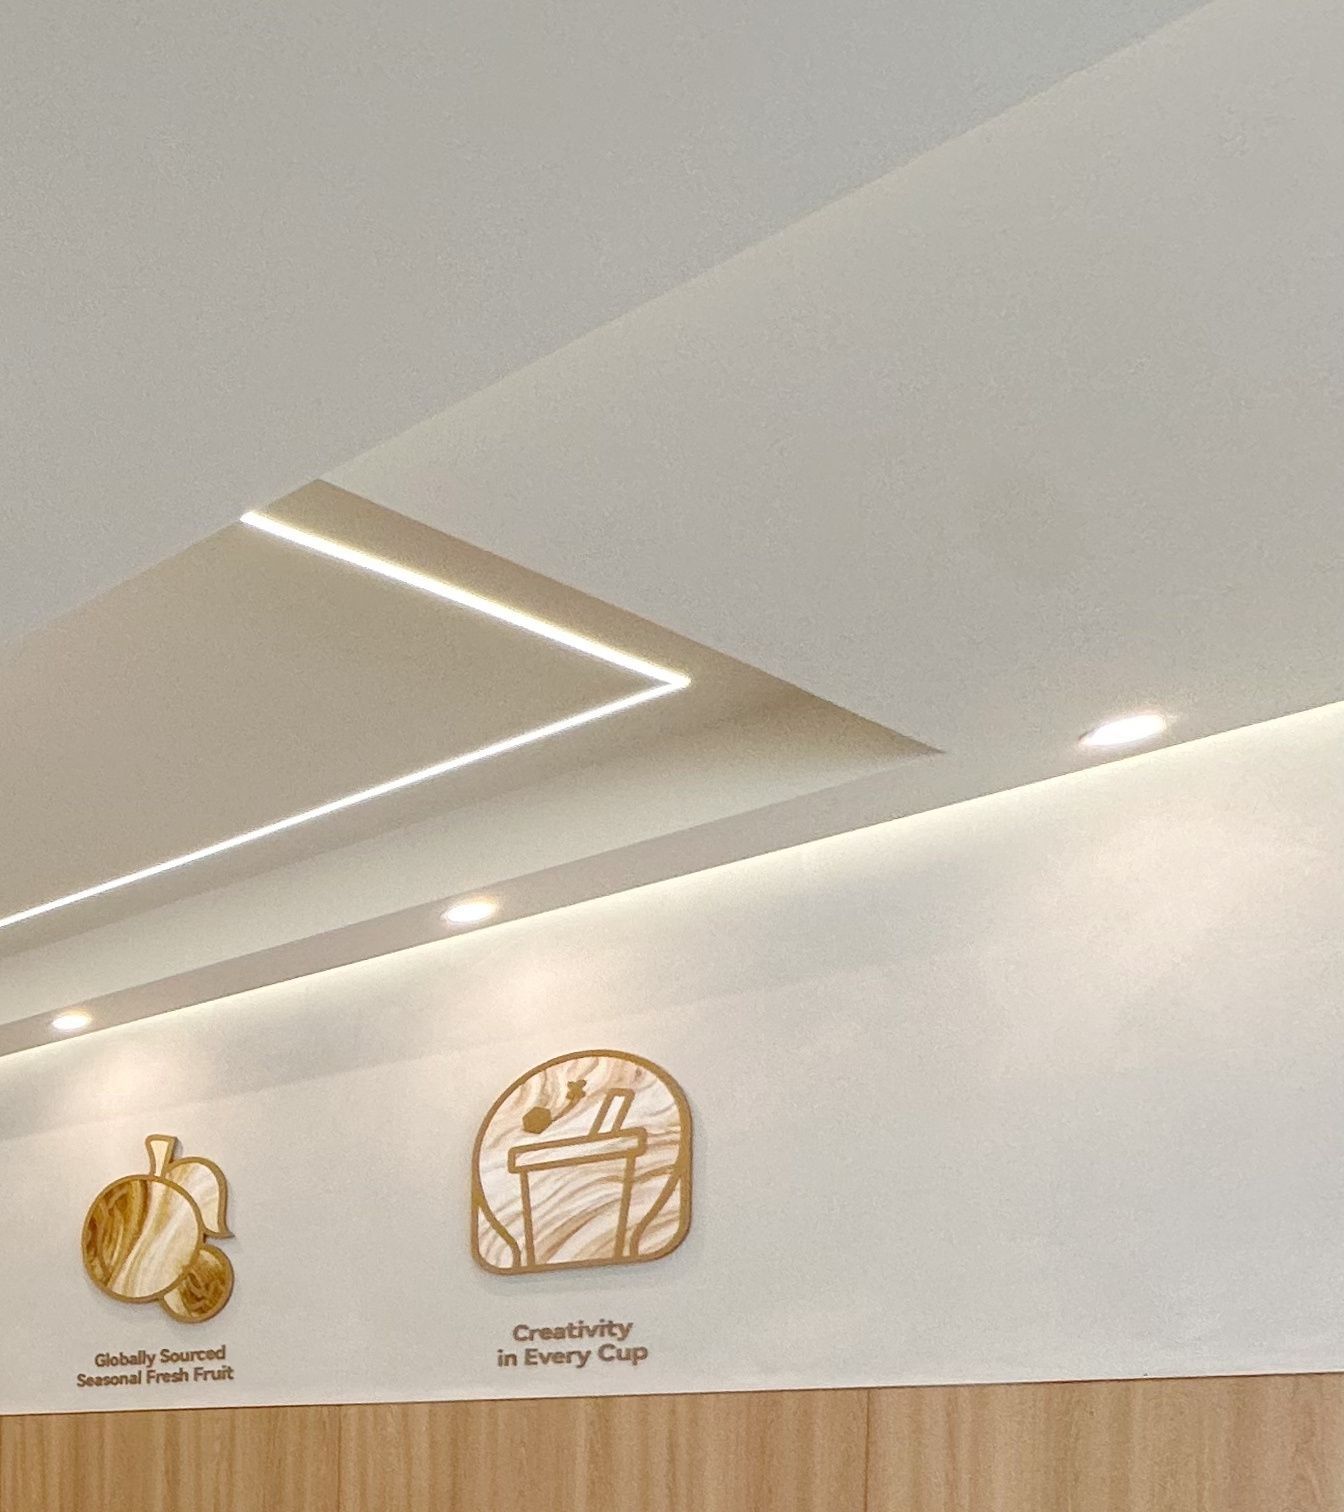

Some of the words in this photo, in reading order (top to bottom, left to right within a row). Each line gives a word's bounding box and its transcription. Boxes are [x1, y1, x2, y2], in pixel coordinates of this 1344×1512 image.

[512, 1318, 634, 1341] Creativity
[94, 1350, 156, 1367] Globally
[160, 1345, 226, 1363] Sourced
[497, 1349, 517, 1367] in
[524, 1347, 592, 1368] Every
[598, 1343, 648, 1366] Cup
[77, 1371, 142, 1387] Seasonal
[146, 1368, 189, 1384] Fresh
[194, 1365, 234, 1381] Fruit
